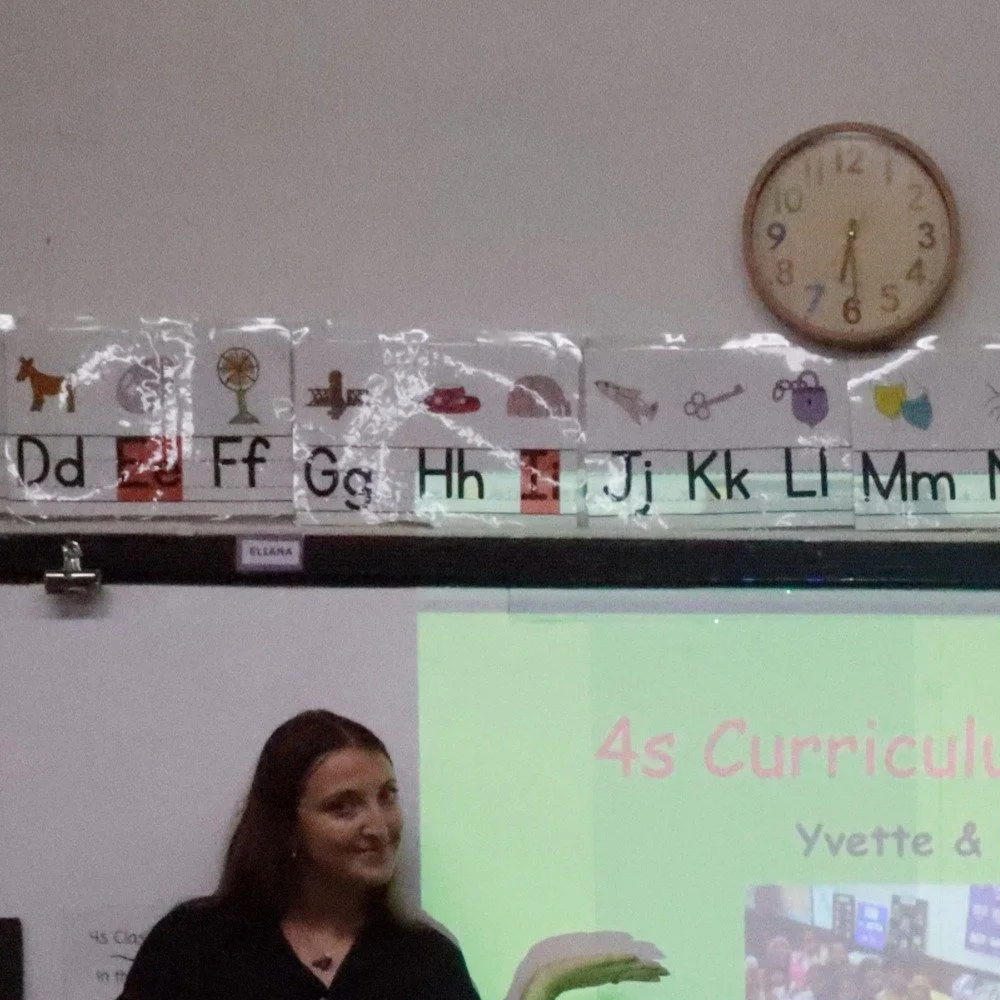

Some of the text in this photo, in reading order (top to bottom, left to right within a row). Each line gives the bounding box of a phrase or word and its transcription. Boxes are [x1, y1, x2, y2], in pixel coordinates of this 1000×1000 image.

[804, 160, 824, 186] 11
[836, 151, 864, 174] 12
[775, 189, 802, 213] 10
[908, 184, 924, 210] 2
[767, 221, 786, 250] 9
[918, 222, 936, 249] 3
[775, 259, 794, 286] 8
[906, 257, 926, 285] 4
[806, 283, 825, 312] 7
[842, 298, 861, 324] 6
[880, 283, 899, 313] 5
[16, 436, 85, 488] Dd
[212, 436, 271, 488] Ff
[304, 446, 374, 510] Gg
[418, 448, 485, 500] Hh
[603, 450, 652, 515] Jj
[687, 450, 750, 501] Kk
[785, 446, 829, 498] Ll
[861, 451, 956, 502] Mm
[594, 716, 676, 779] 4s
[795, 823, 934, 858] Yvette
[953, 821, 982, 858] &
